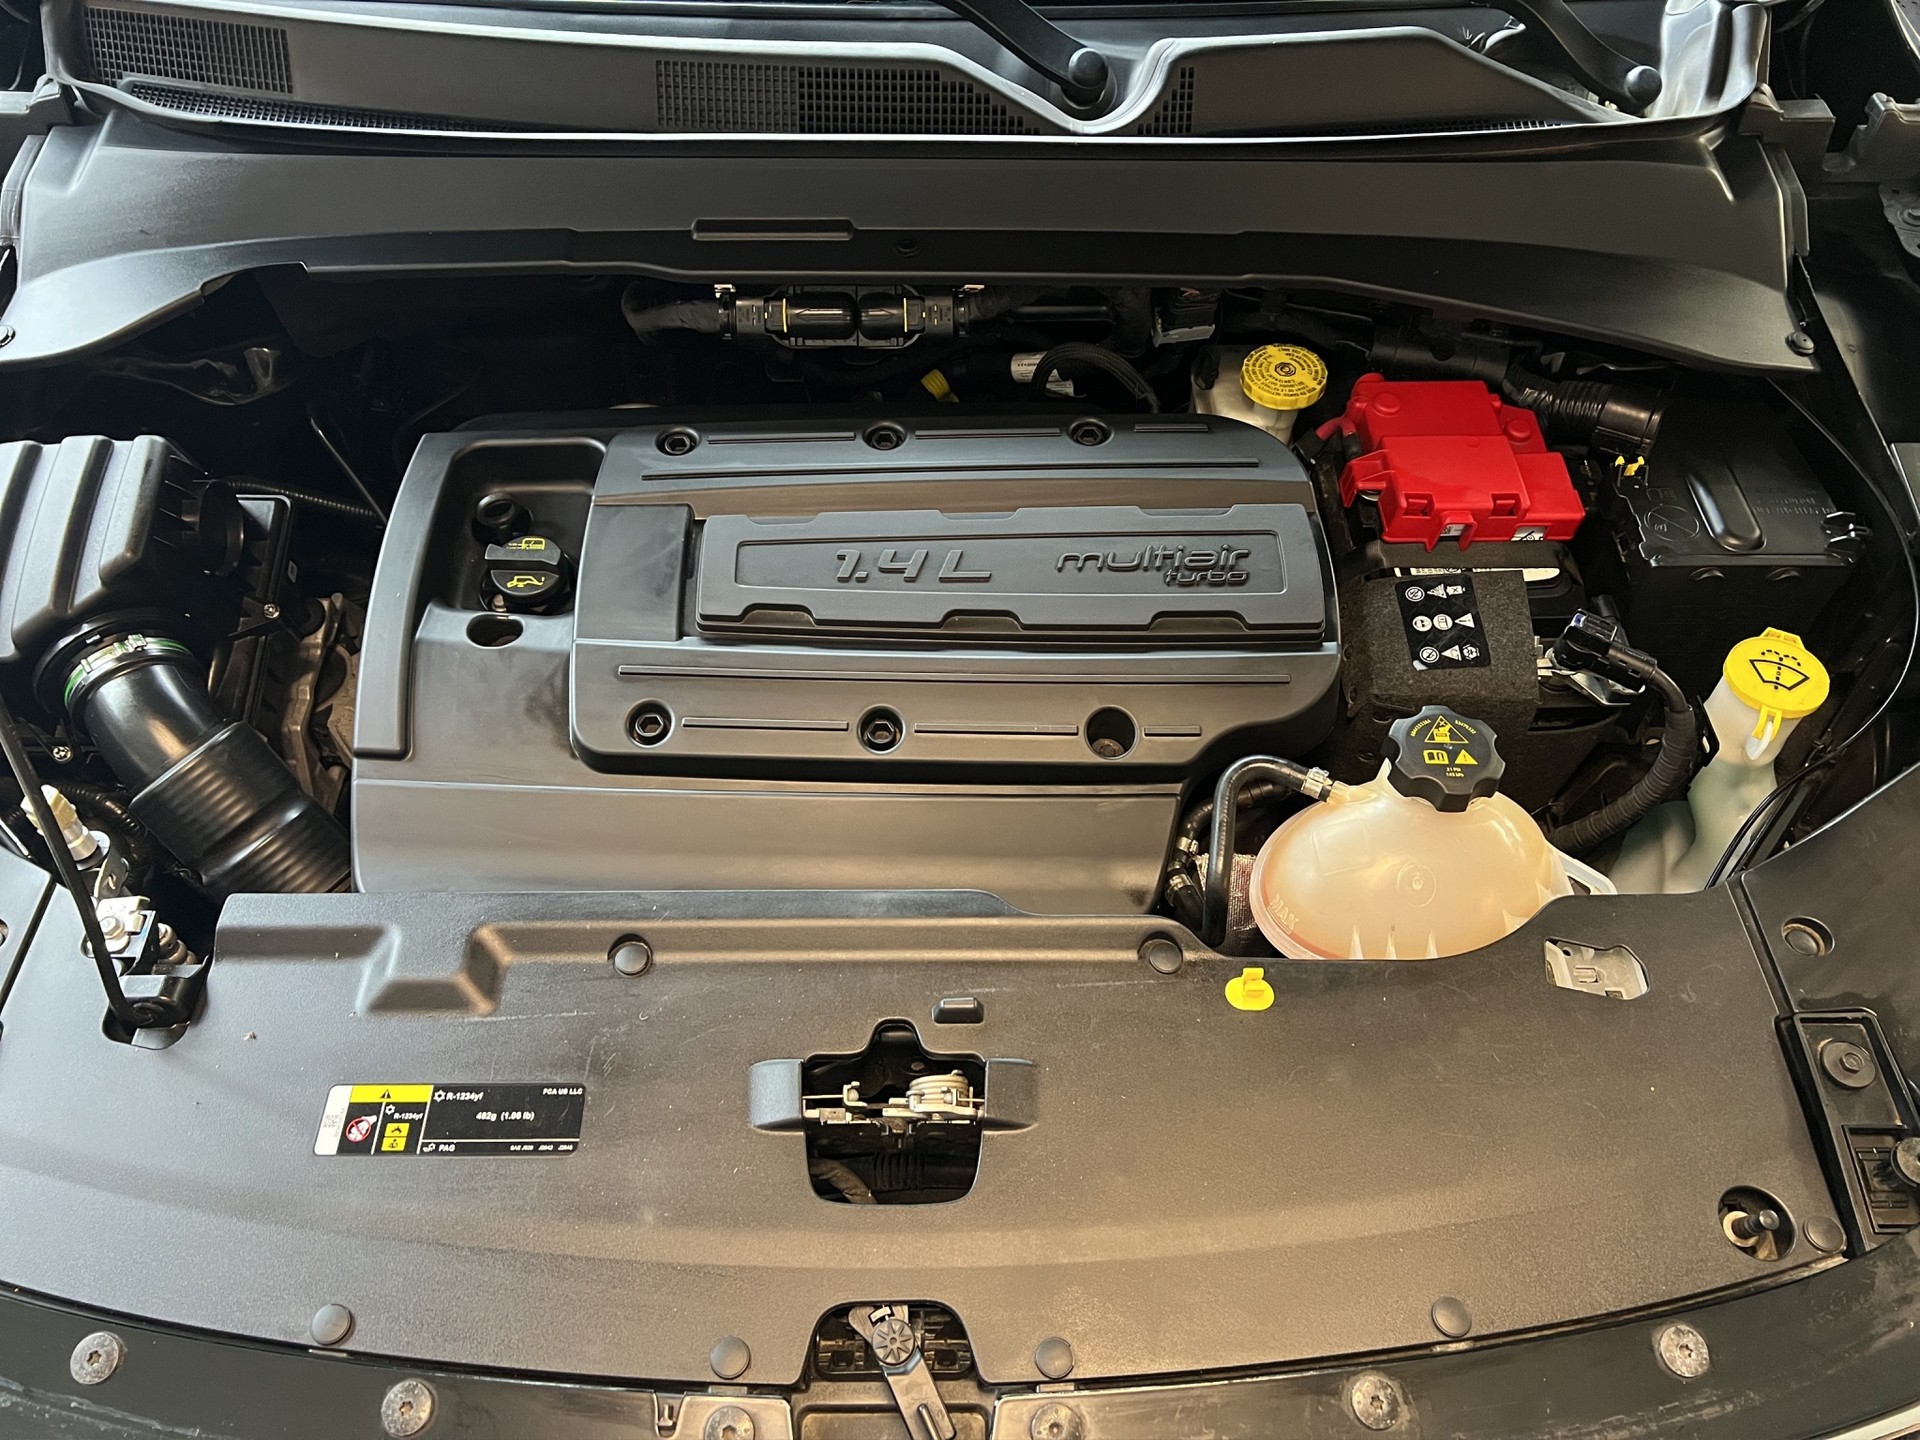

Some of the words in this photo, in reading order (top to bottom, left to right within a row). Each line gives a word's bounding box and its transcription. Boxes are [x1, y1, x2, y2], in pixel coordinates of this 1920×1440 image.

[1056, 543, 1252, 572] multiair
[1163, 568, 1250, 586] turbo
[446, 1091, 484, 1102] R-1234yf
[569, 1087, 584, 1095] LLC
[522, 1111, 535, 1122] lb)
[438, 1144, 456, 1152] PAG
